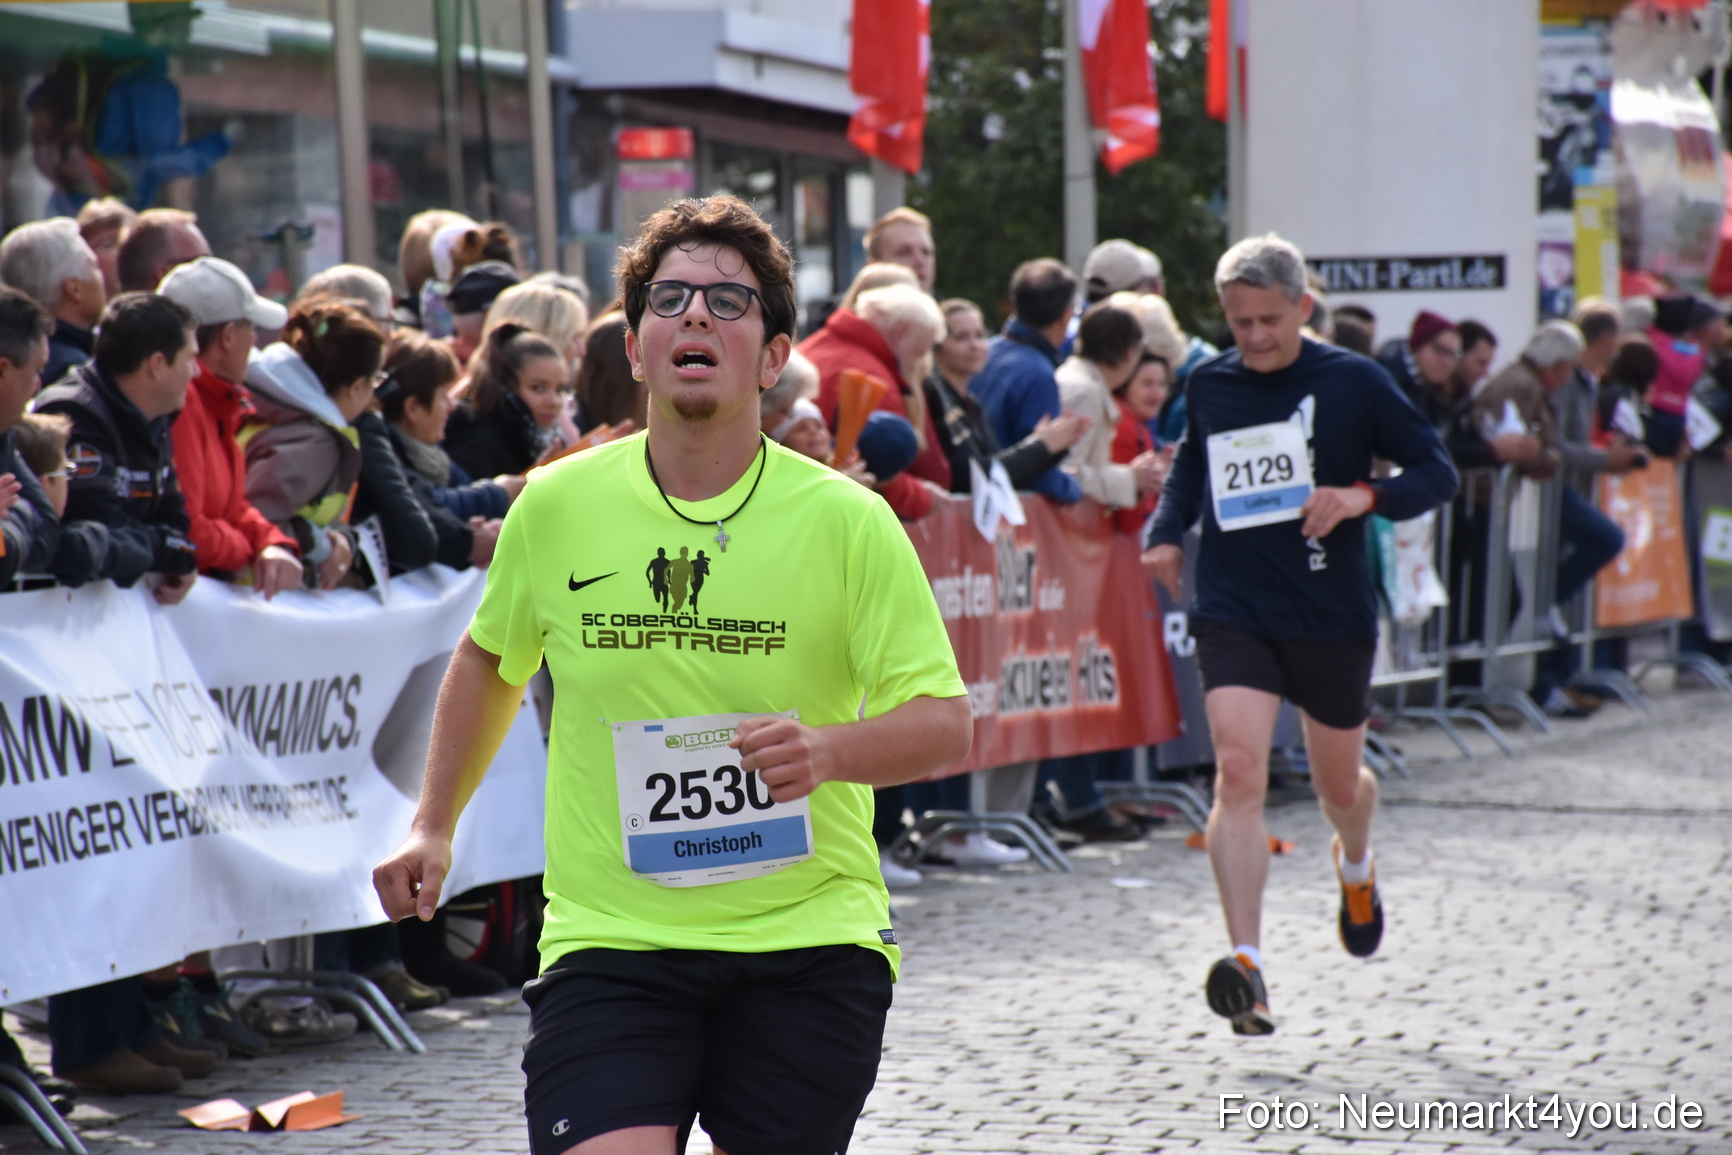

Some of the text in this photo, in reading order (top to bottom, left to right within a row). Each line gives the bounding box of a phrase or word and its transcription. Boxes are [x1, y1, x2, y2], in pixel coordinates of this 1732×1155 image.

[1224, 453, 1294, 490] 2129
[581, 613, 606, 626] SC
[673, 831, 763, 858] Christoph
